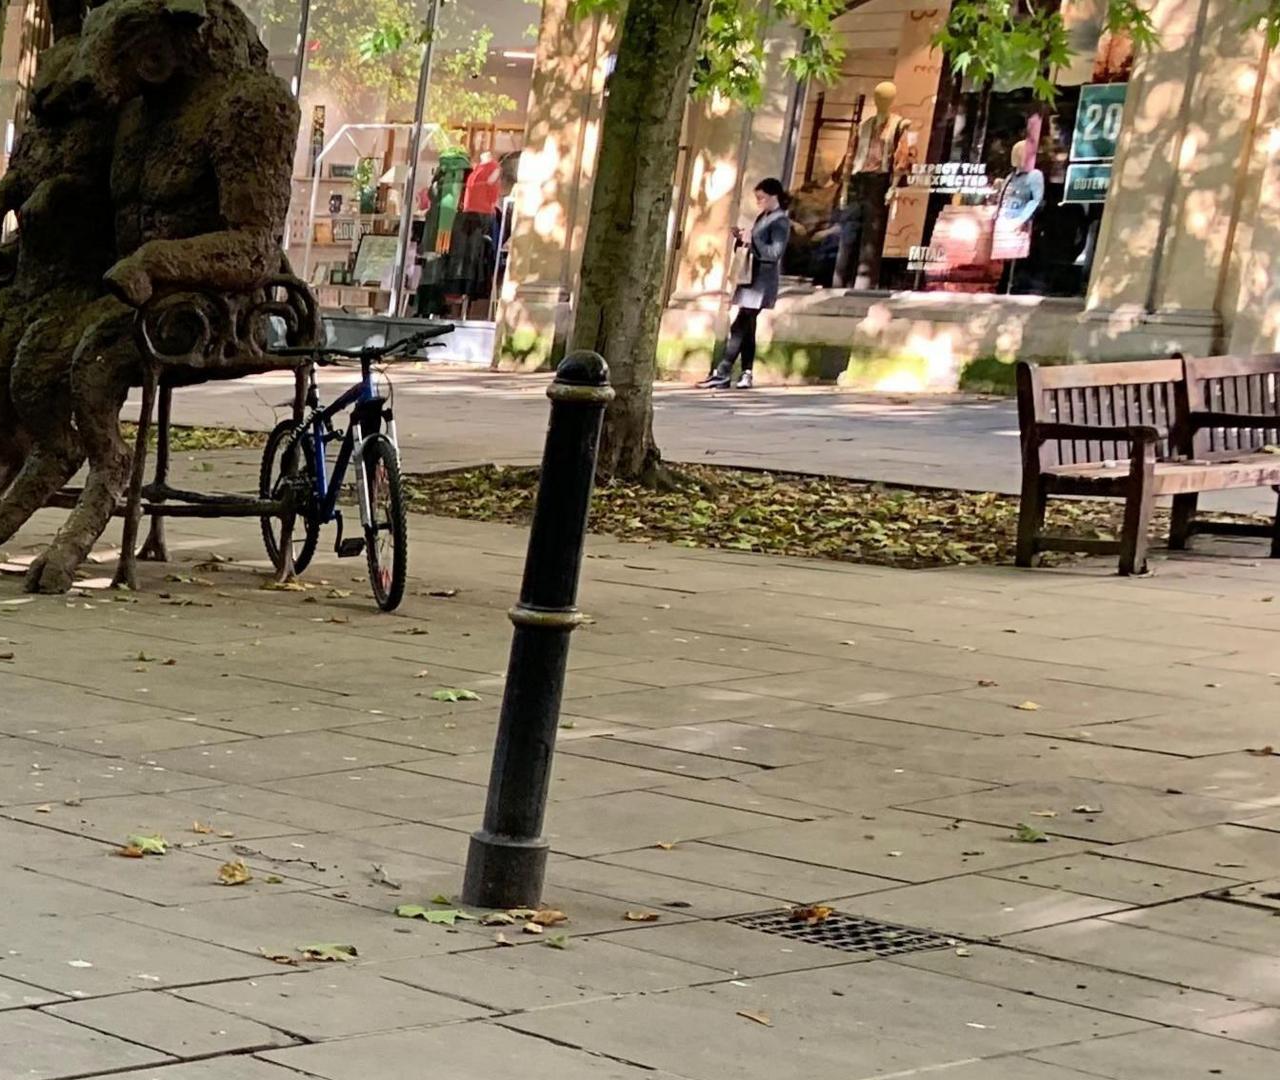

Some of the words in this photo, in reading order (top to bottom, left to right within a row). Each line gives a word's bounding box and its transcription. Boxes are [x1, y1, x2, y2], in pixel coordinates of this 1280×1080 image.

[911, 163, 960, 174] EXPECT
[961, 163, 987, 174] THE
[906, 175, 989, 187] UNEXPECTED
[1073, 177, 1110, 190] OUTER
